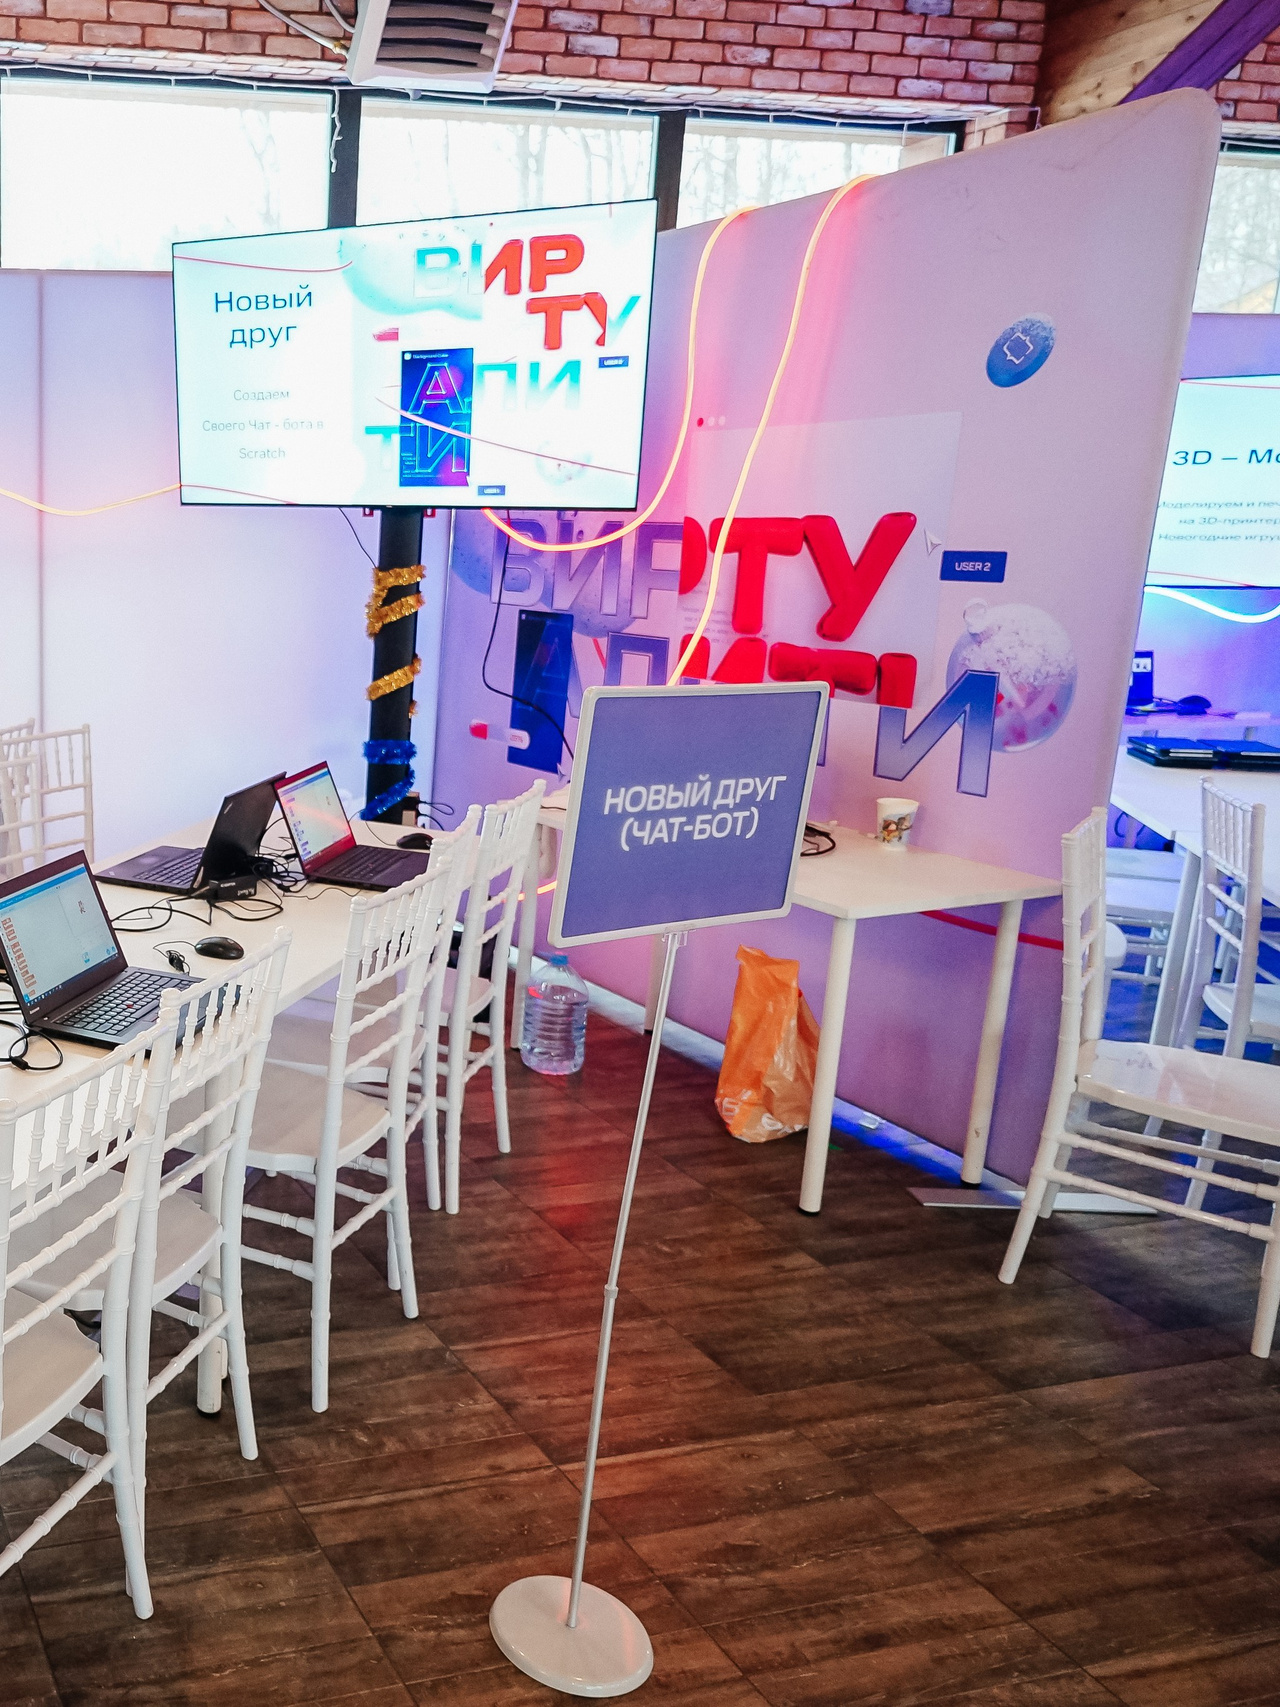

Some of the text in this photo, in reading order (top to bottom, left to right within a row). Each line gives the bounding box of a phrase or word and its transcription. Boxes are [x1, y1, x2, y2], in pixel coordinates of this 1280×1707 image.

[413, 233, 586, 298] ВИР
[214, 284, 313, 313] Новый
[525, 291, 642, 350] ТУ
[229, 325, 298, 349] друг
[233, 388, 291, 401] Создаем
[202, 420, 246, 432] Своего
[248, 419, 272, 430] Чат
[283, 418, 313, 430] бота
[317, 420, 325, 429] в
[238, 447, 287, 459] Scratch
[364, 420, 471, 473] ТИ
[1172, 450, 1213, 466] 3D
[1158, 533, 1242, 542] Новогодние
[490, 511, 918, 643] ВИРТУ
[955, 561, 991, 572] USER 2
[603, 773, 788, 815] НОВЫЙ ДРУГ
[620, 806, 760, 852] (ЧАТ-БОТ)
